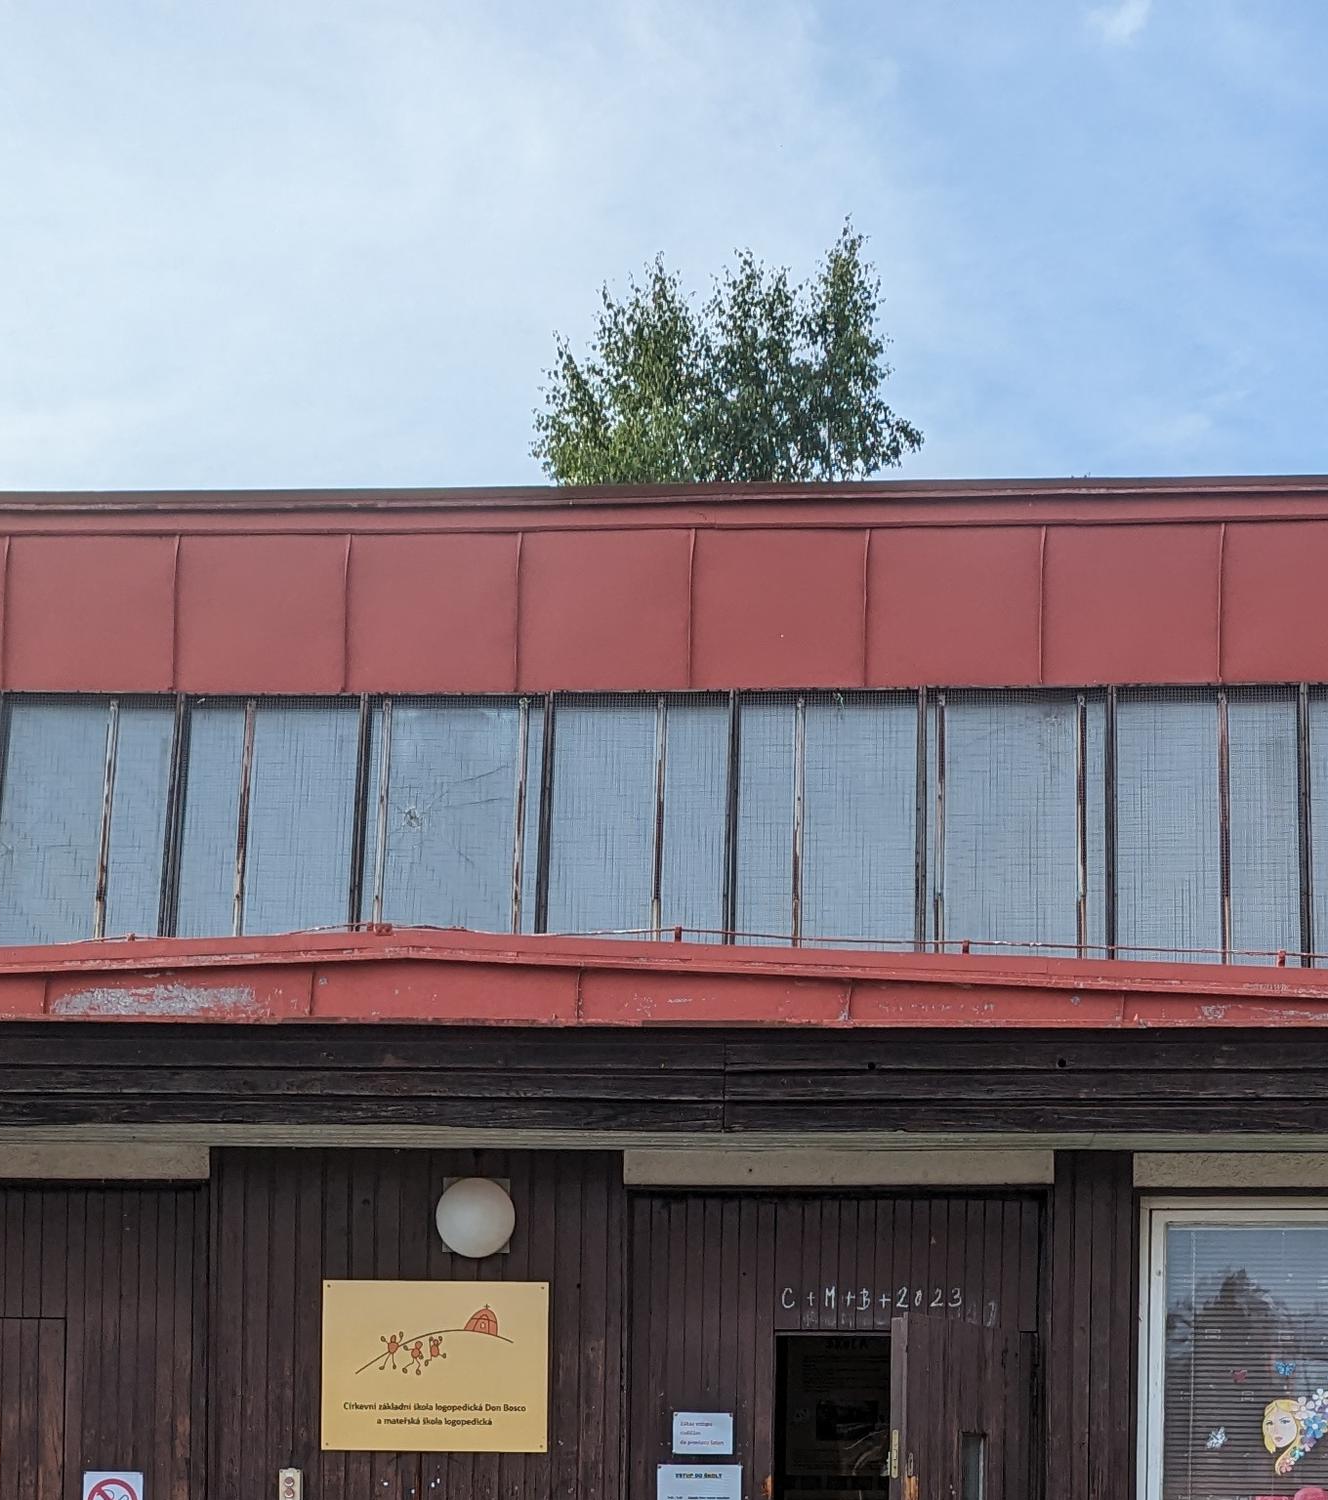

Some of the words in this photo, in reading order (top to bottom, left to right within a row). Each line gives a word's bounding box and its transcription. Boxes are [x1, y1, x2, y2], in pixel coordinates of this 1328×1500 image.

[343, 1401, 377, 1411] Církevní
[378, 1402, 412, 1411] základní
[413, 1402, 434, 1411] škola
[435, 1402, 483, 1413] logopedická
[484, 1403, 502, 1412] Don
[503, 1403, 527, 1412] Bosco
[383, 1417, 421, 1425] mateřská
[422, 1417, 443, 1426] škola
[444, 1417, 493, 1428] logopedická
